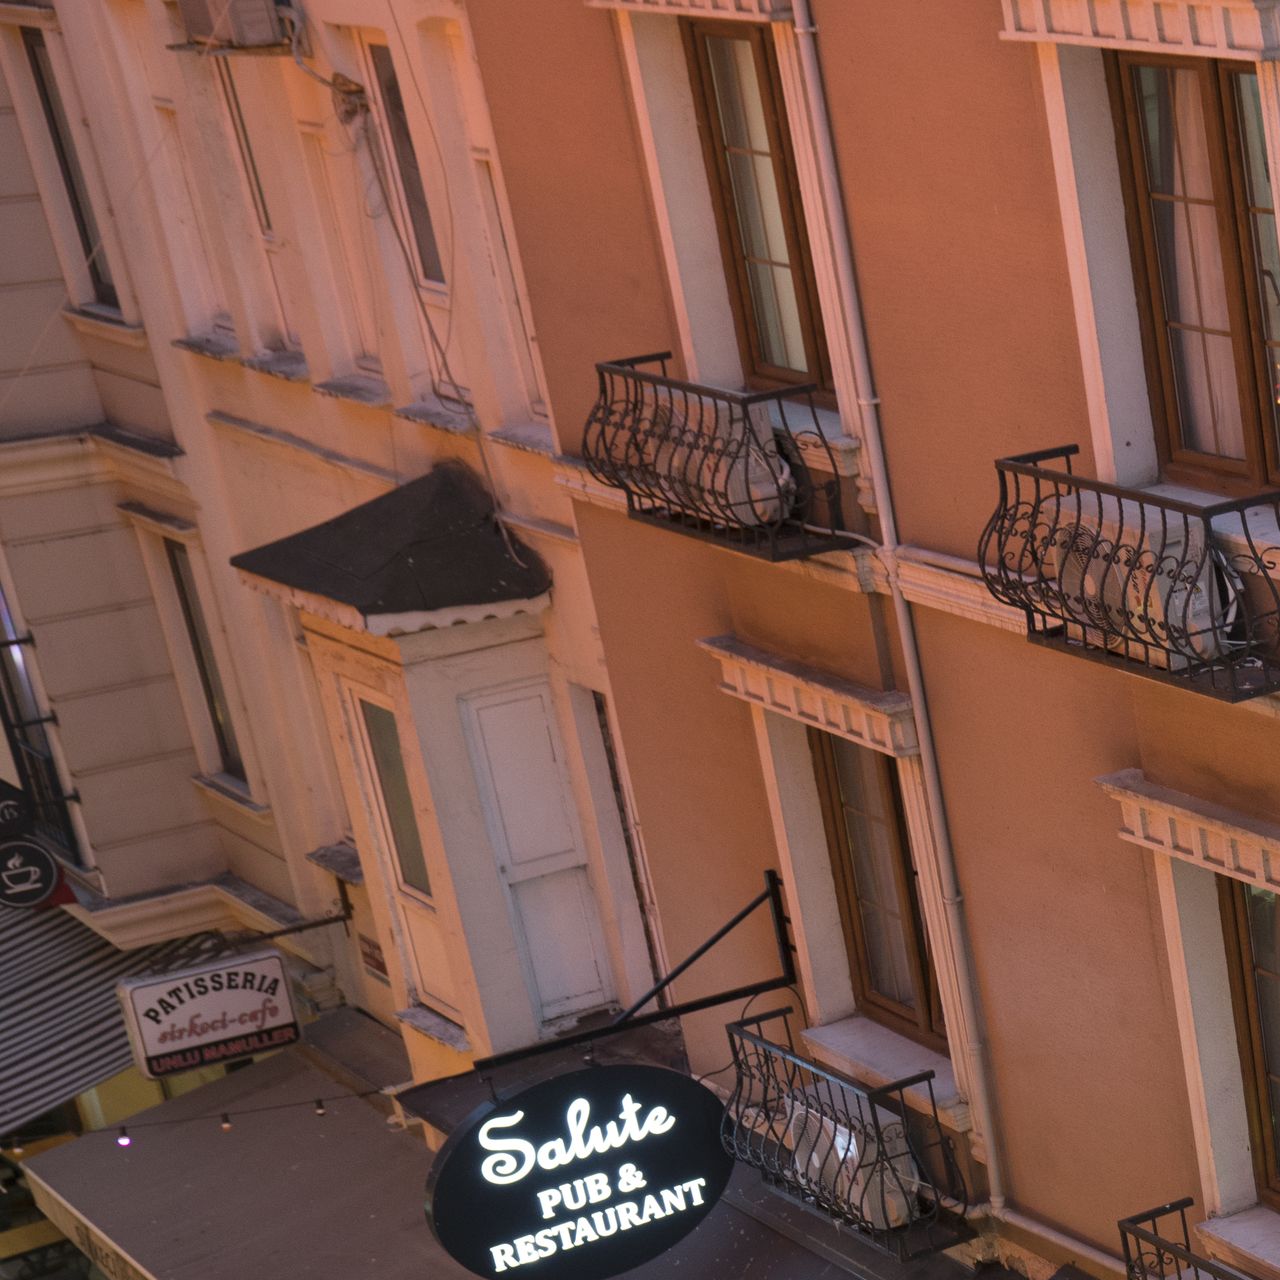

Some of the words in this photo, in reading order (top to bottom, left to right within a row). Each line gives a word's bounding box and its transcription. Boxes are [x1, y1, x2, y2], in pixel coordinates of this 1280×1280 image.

[143, 971, 280, 1025] PATISSERIA
[478, 1093, 676, 1185] Salute
[489, 1178, 706, 1273] RESTAURANT
[537, 1172, 612, 1219] PUB
[617, 1163, 647, 1193] &
